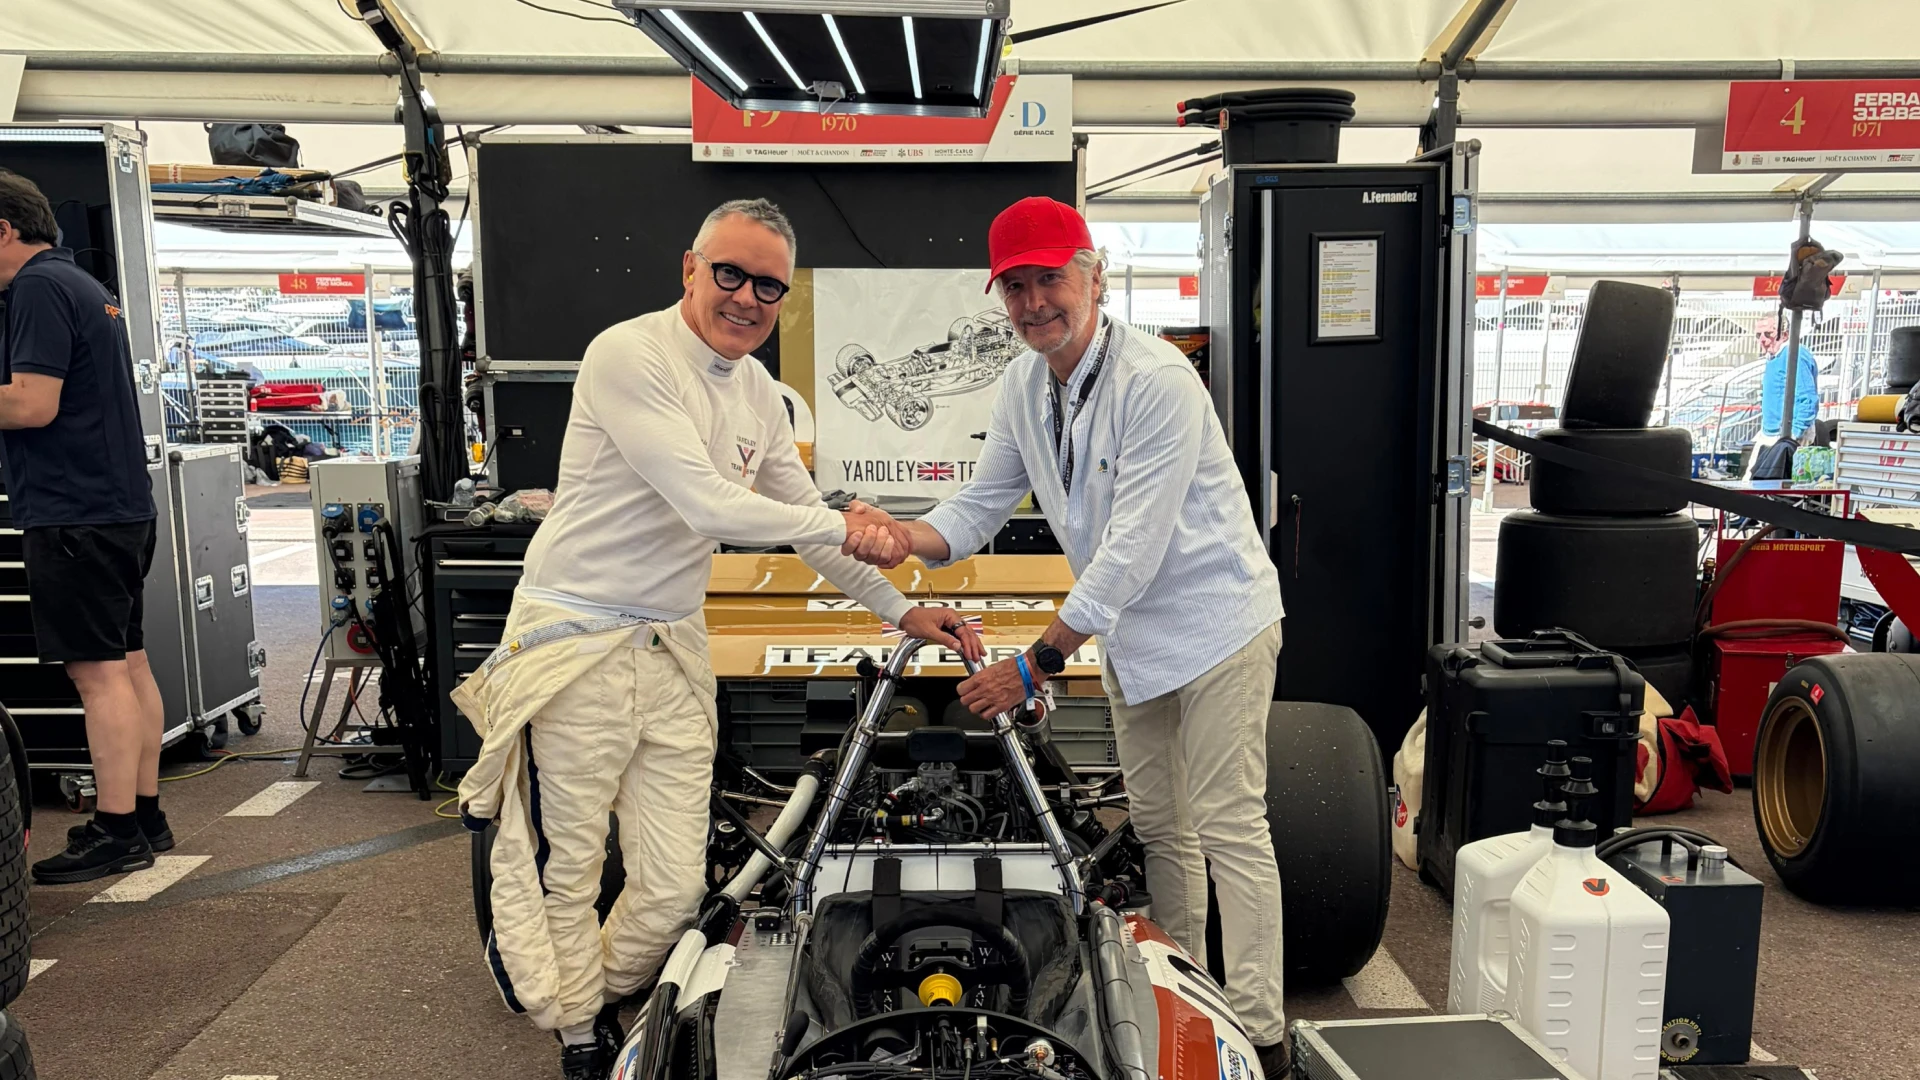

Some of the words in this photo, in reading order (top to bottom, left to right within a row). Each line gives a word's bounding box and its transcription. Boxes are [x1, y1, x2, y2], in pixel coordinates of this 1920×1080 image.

[1854, 92, 1920, 107] FERRA
[1022, 102, 1046, 127] D
[1780, 96, 1806, 134] 4
[1852, 107, 1920, 121] 312B2
[821, 116, 857, 131] 1970
[1852, 122, 1881, 137] 1971
[907, 149, 923, 157] UBS
[1362, 191, 1418, 204] A.Fernandez
[290, 277, 308, 290] 48
[842, 460, 916, 482] YARDLEY
[1772, 543, 1826, 552] MOTORSPORT
